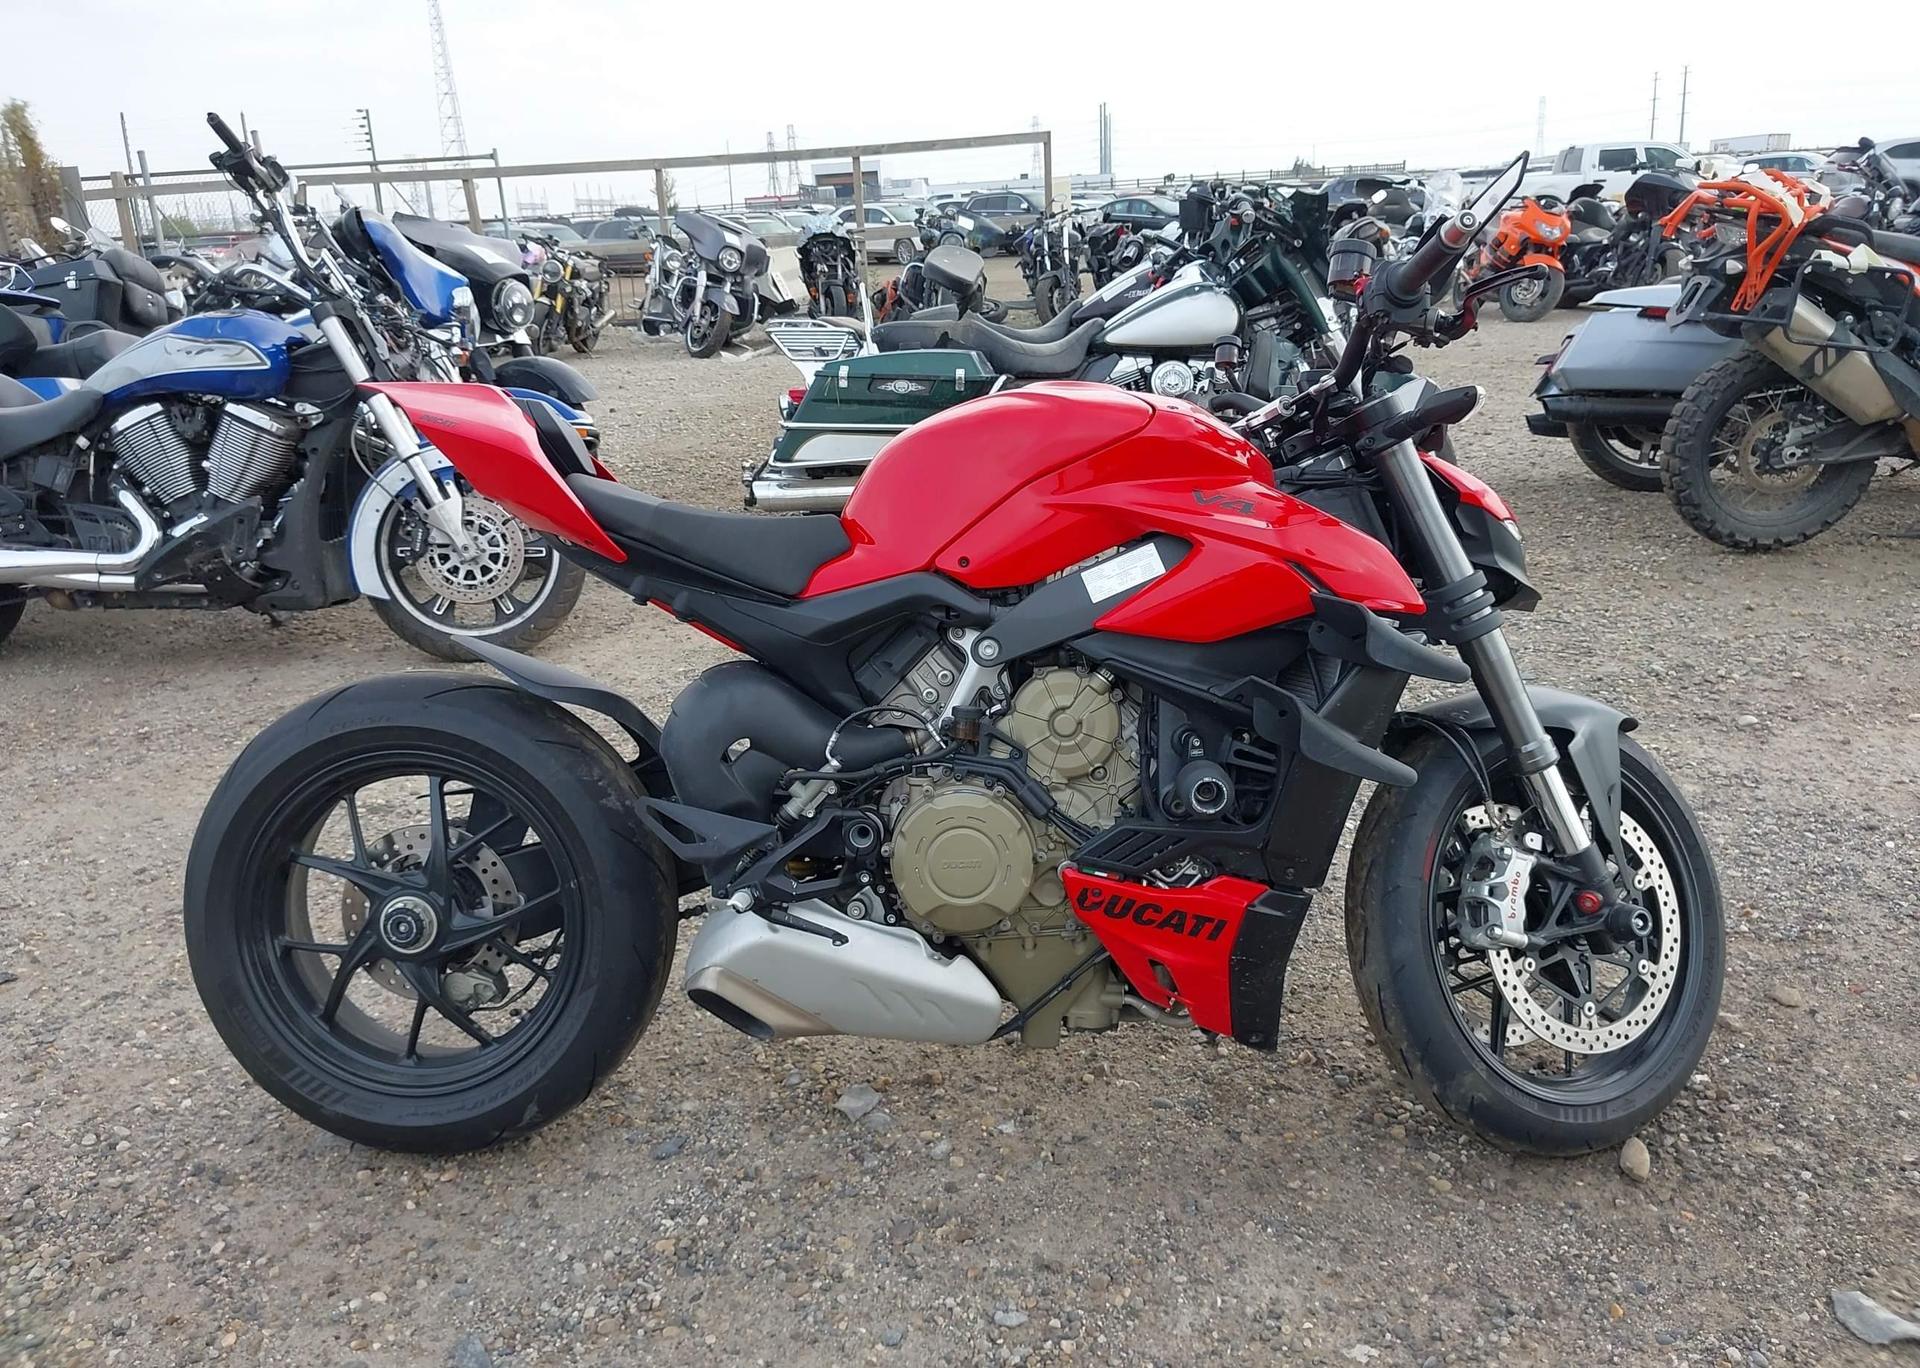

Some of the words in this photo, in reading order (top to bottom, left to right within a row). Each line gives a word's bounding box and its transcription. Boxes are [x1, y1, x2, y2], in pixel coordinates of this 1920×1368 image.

[1192, 488, 1255, 514] V4
[1076, 887, 1229, 941] DUCATI
[1508, 871, 1521, 919] brembo
